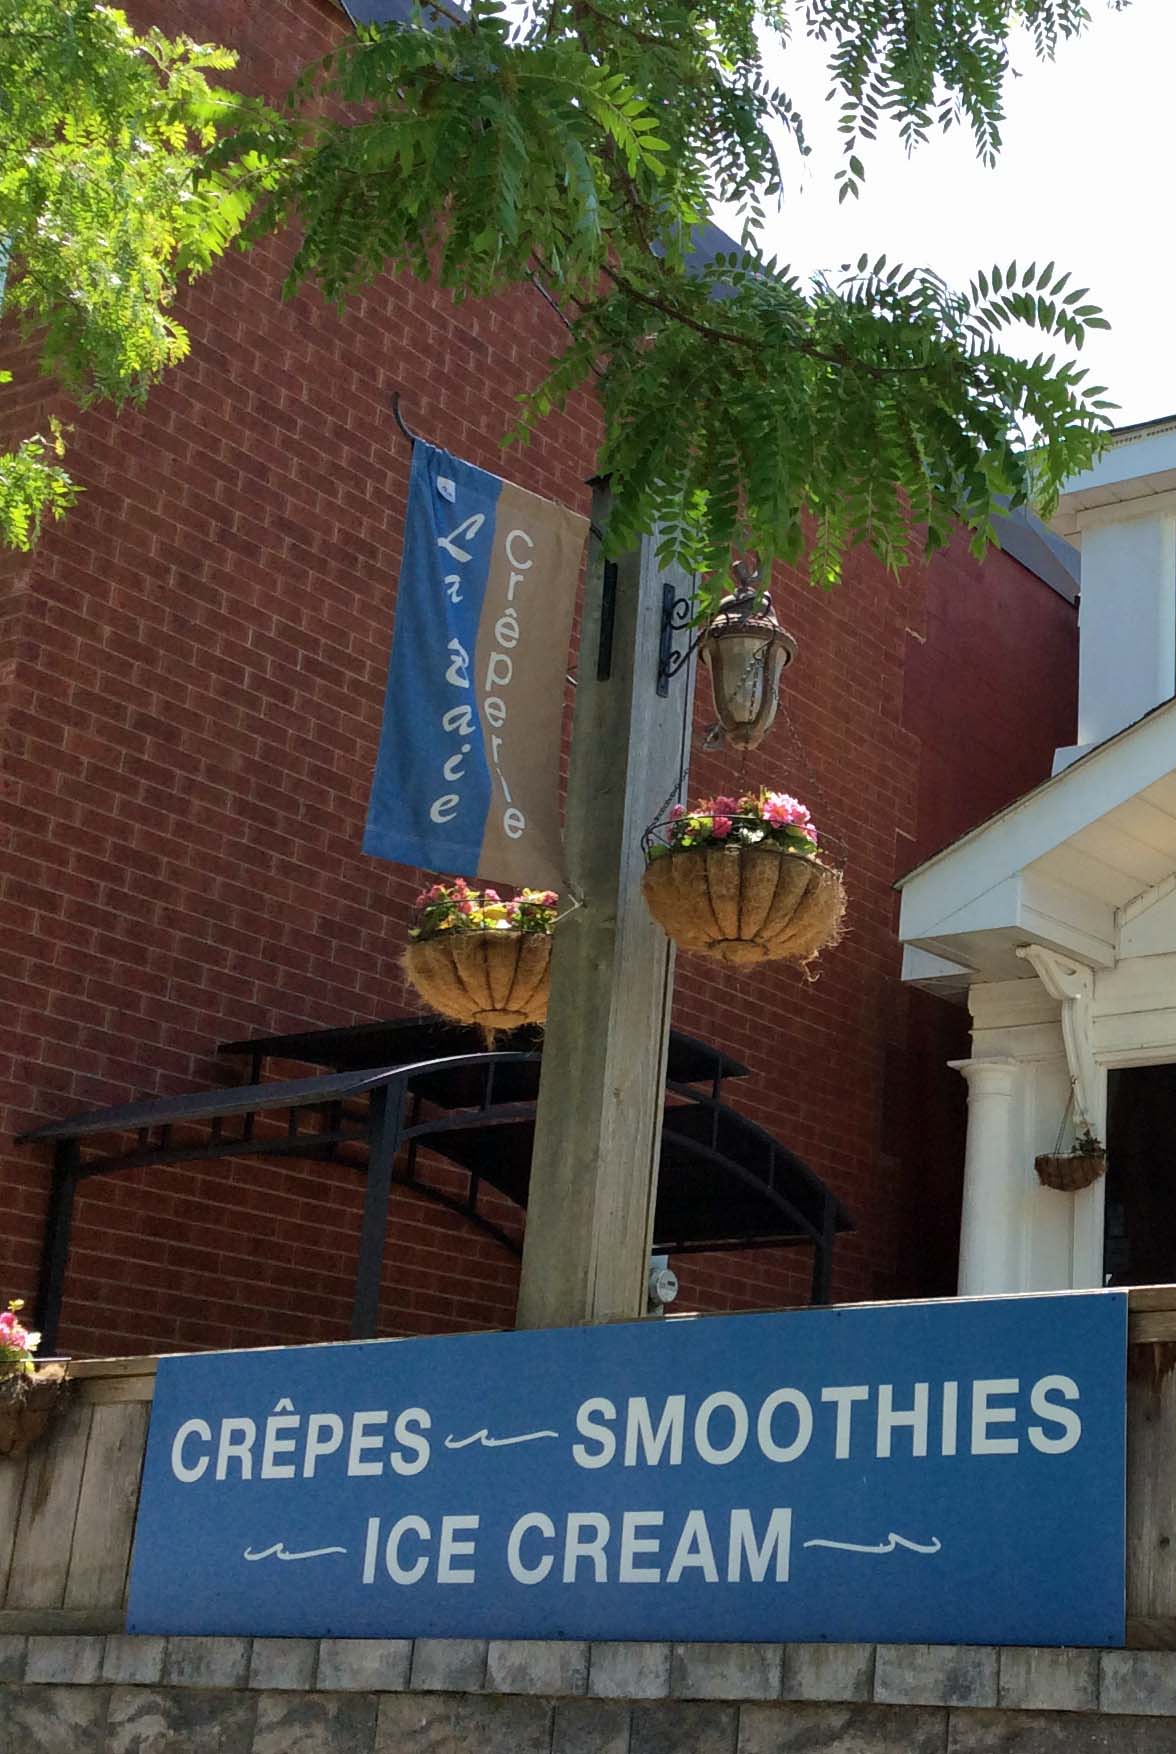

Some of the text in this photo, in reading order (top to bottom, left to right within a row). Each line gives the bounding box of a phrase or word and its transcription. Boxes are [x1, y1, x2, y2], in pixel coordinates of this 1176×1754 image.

[484, 529, 534, 840] Crêperie
[171, 1374, 1082, 1484] CRÊPES SMOOTHIES
[363, 1508, 792, 1585] ICE CREAM
